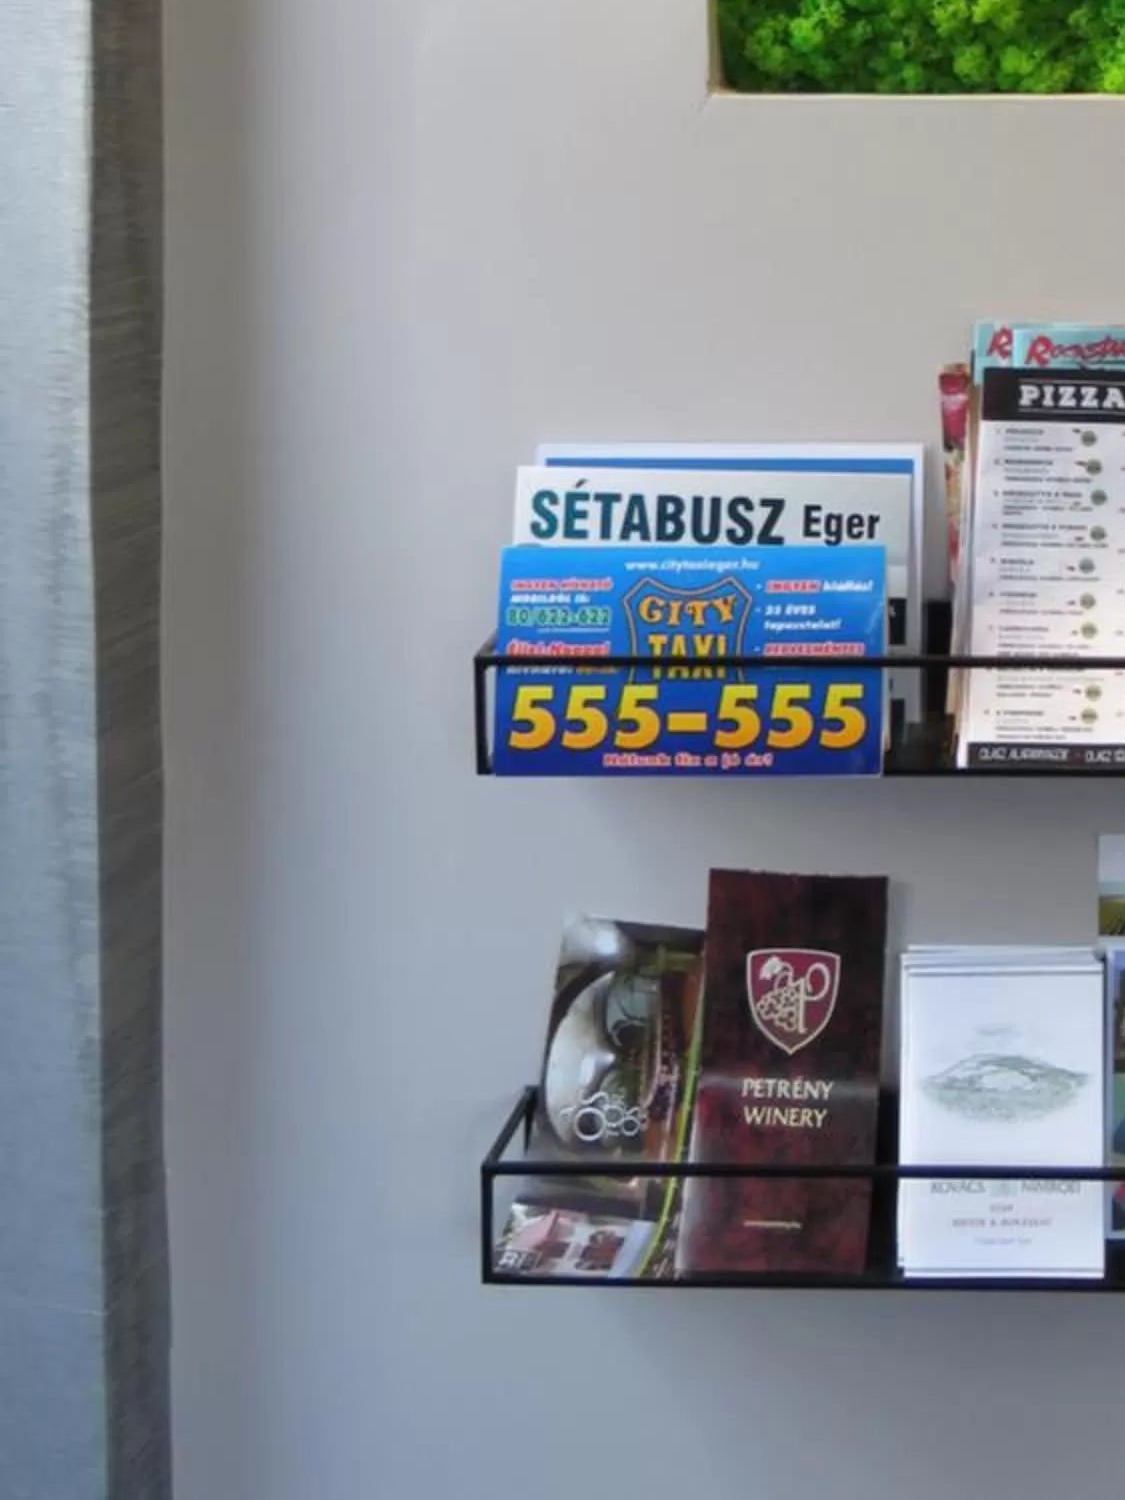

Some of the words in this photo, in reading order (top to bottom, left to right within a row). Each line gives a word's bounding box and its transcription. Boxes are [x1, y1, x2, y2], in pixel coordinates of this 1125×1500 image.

[529, 479, 786, 546] SÉTABUSZ
[802, 504, 881, 545] Eger
[647, 633, 728, 680] TAXI
[508, 684, 867, 751] 555-555
[741, 1074, 835, 1101] PETRÉNY
[743, 1105, 829, 1130] WINERY
